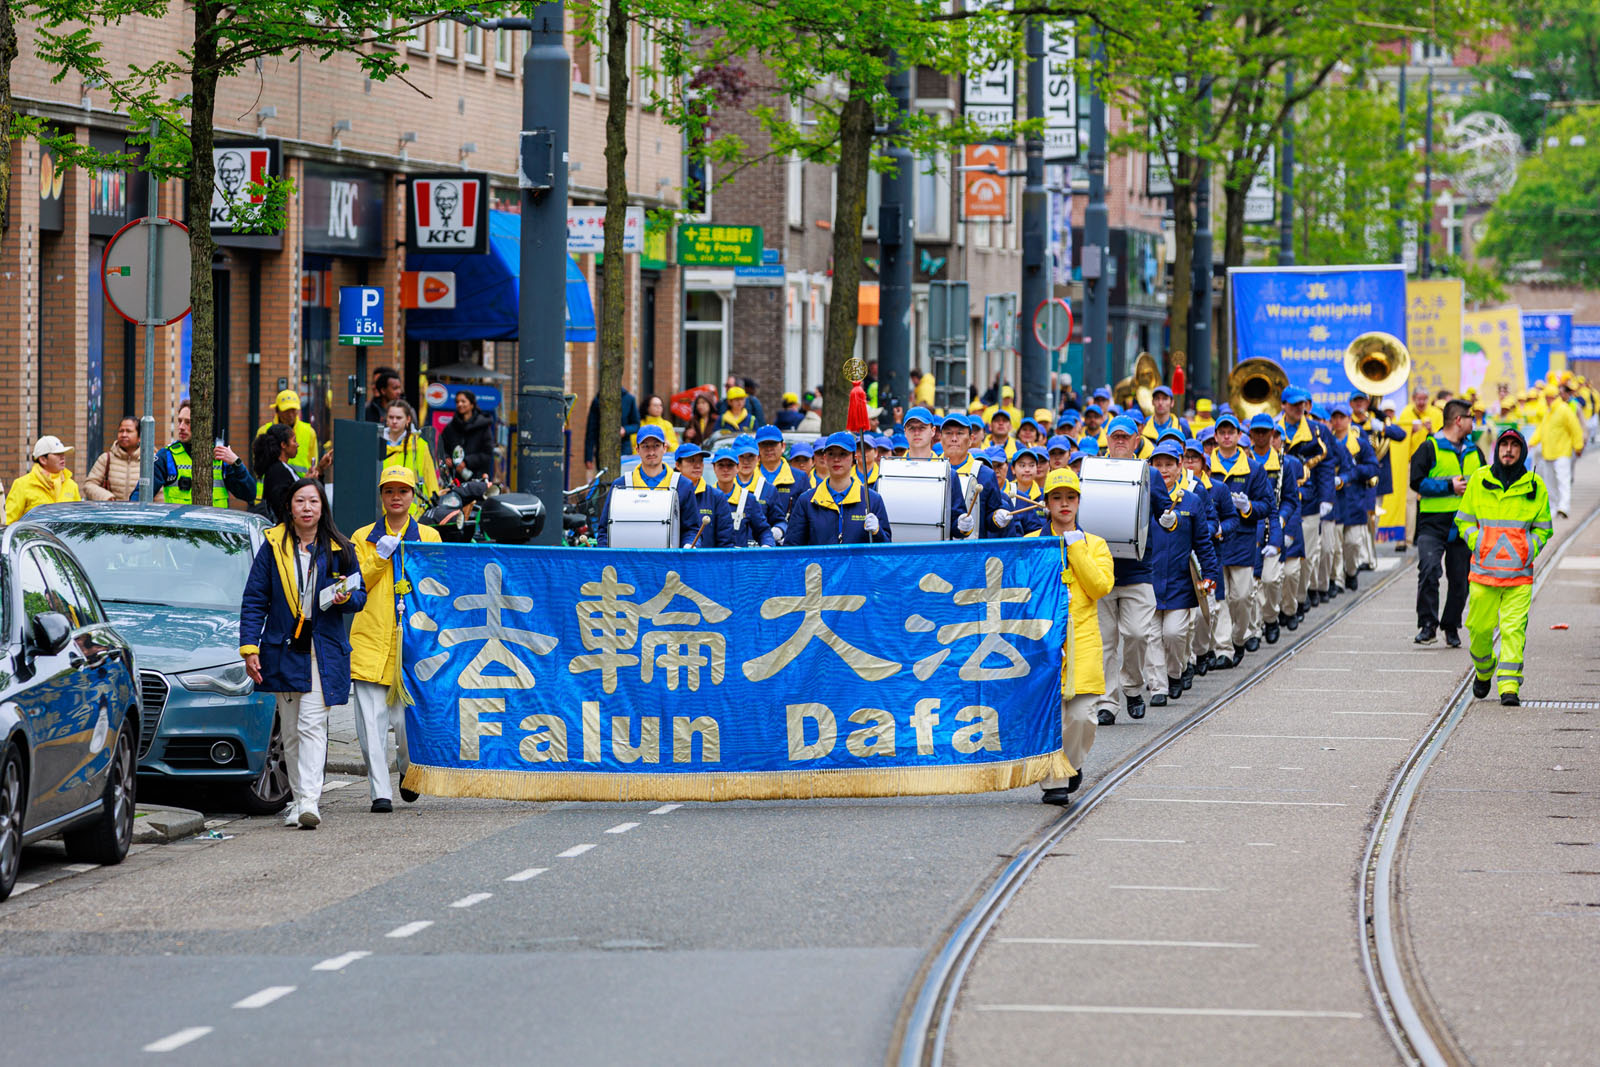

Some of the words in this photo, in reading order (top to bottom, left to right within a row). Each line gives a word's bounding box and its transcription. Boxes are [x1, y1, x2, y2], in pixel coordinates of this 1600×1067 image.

[328, 181, 358, 239] KFC
[427, 230, 466, 243] KFC
[362, 289, 380, 317] P
[1266, 302, 1372, 319] Waarachtigheid
[408, 556, 1053, 694] 法輪大法
[458, 697, 721, 764] Falun
[786, 697, 1002, 763] Dafa
